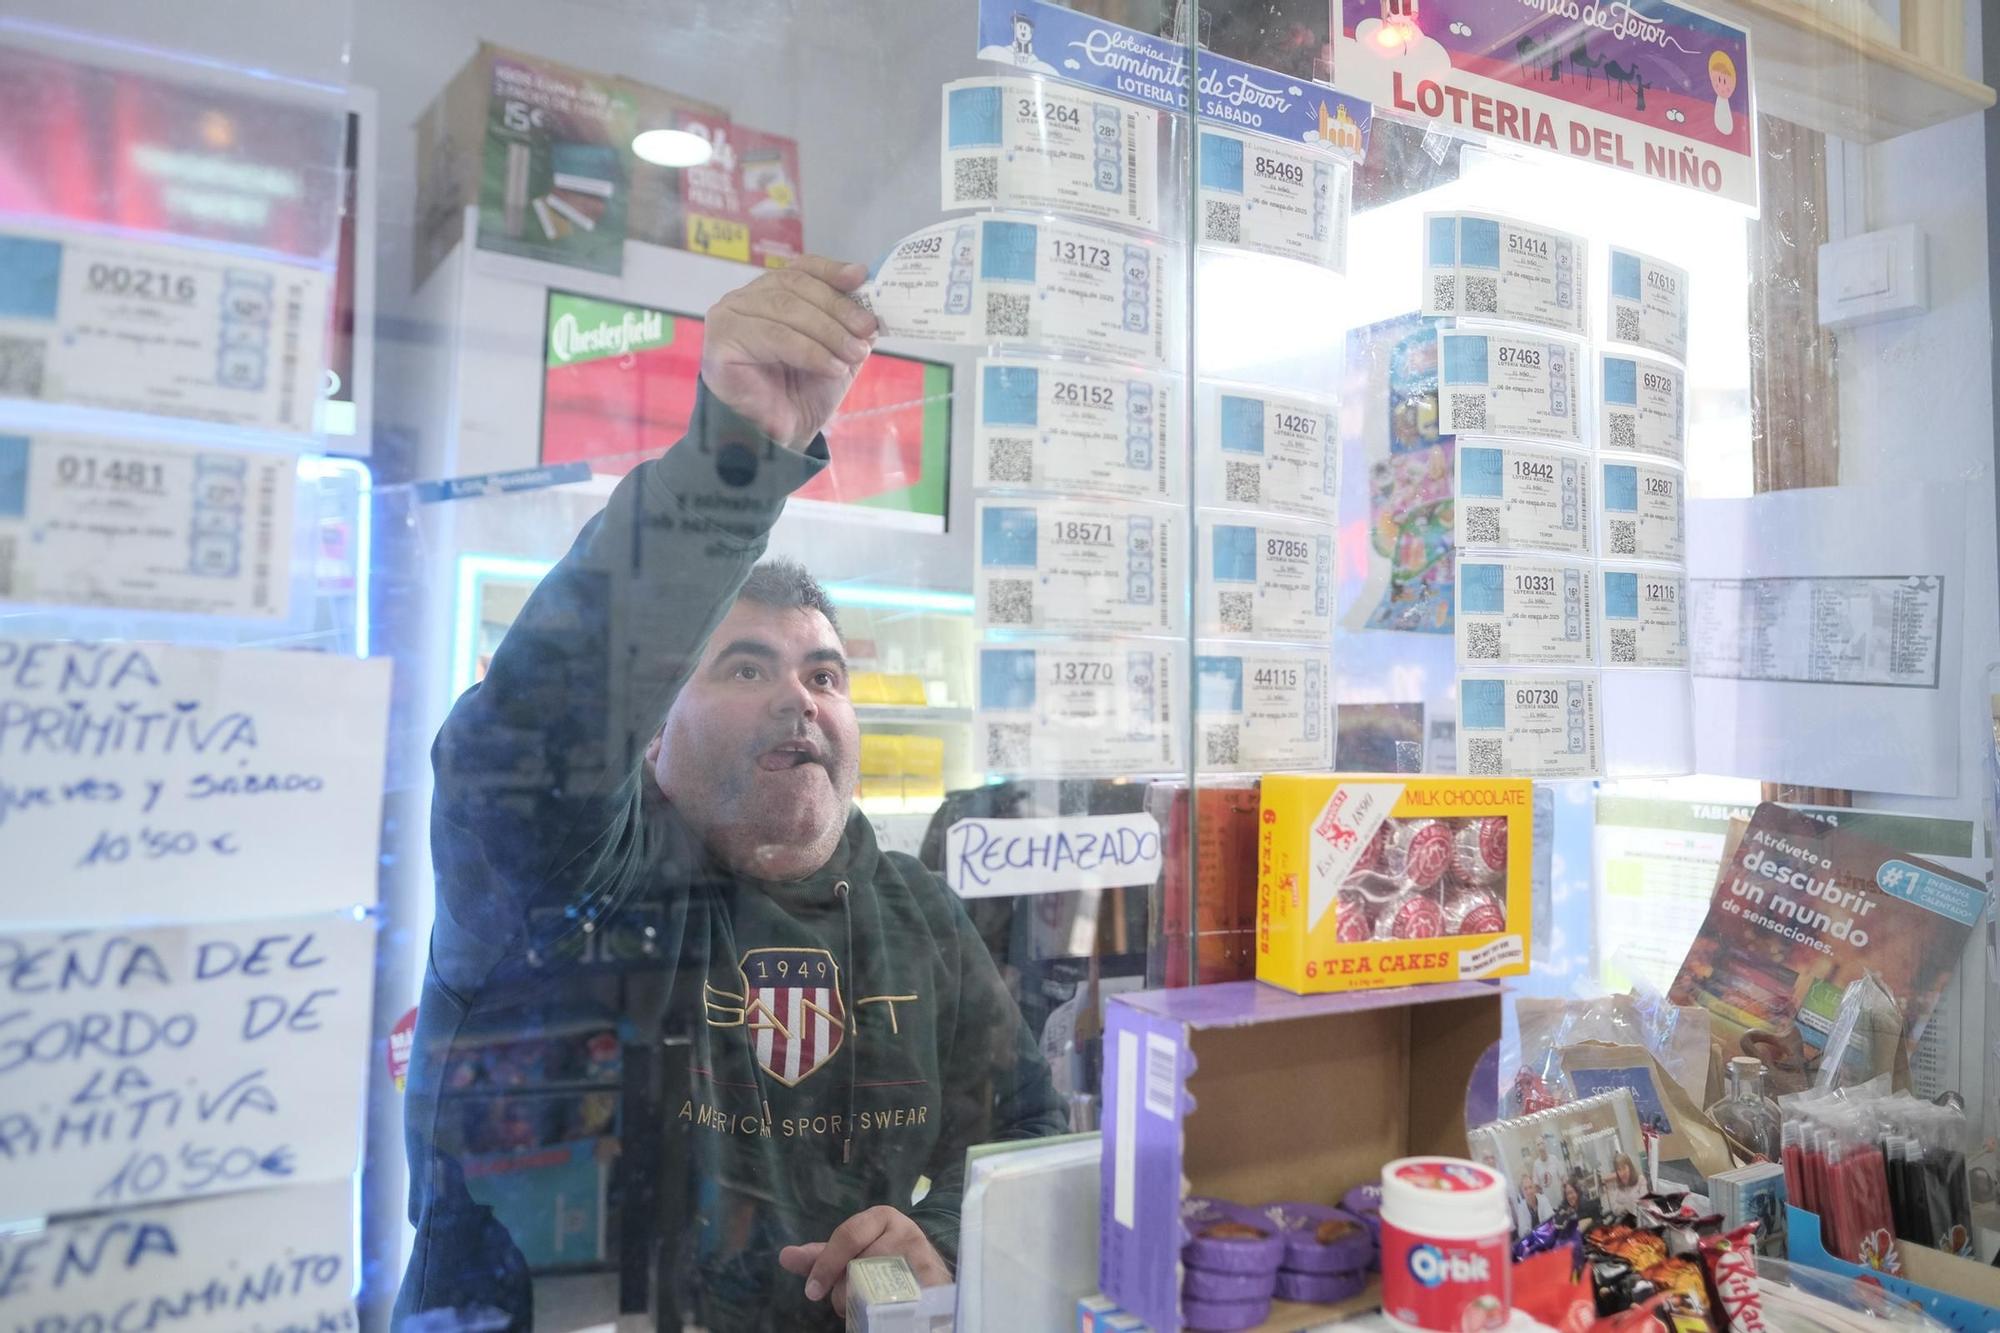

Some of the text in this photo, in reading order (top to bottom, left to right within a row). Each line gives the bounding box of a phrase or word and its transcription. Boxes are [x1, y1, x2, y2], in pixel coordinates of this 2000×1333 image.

[1582, 0, 1608, 27] de
[1610, 0, 1667, 48] Teror
[1116, 75, 1175, 105] LOTERIA
[1178, 93, 1203, 113] DL
[1206, 101, 1263, 128] SÁBADO
[1199, 69, 1228, 98] de
[1227, 73, 1293, 114] Teror
[1391, 70, 1723, 193] LOTERIA DEL NIÑO
[1255, 156, 1303, 182] 85469
[1052, 239, 1110, 267] 13173
[1508, 233, 1548, 255] 51414
[88, 263, 198, 301] 00216
[1647, 270, 1676, 292] 47619
[551, 309, 663, 370] Chesterfield
[1499, 346, 1540, 365] 87463
[1054, 382, 1113, 405] 26152
[1643, 372, 1672, 392] 69728
[1275, 413, 1317, 435] 14267
[57, 454, 166, 489] 01481
[1514, 460, 1553, 479] 18442
[1644, 477, 1673, 495] 12687
[1054, 521, 1112, 542] 18571
[1267, 538, 1308, 558] 87856
[1515, 574, 1555, 591] 10331
[1646, 583, 1675, 599] 12116
[1053, 662, 1113, 680] 13770
[1254, 668, 1297, 686] 44115
[1516, 689, 1558, 704] 60730
[0, 699, 259, 755] PRIMITIVA
[144, 777, 165, 814] y
[1405, 789, 1526, 807] MILK CHOCOLATE
[1262, 809, 1276, 824] 6
[951, 822, 1159, 891] RECHAZADO
[1262, 831, 1272, 877] TEA
[1752, 829, 1819, 865] Atrévete
[1820, 858, 1832, 870] a
[1742, 849, 1877, 917] descubrir
[1881, 867, 1921, 896] #1
[1721, 898, 1835, 956] de sensaciones.
[1730, 877, 1870, 948] un mundo
[195, 933, 328, 981] DEL
[756, 960, 827, 979] 1949
[1305, 960, 1317, 978] 6
[1324, 955, 1373, 976] TEA
[1378, 951, 1450, 973] CAKES
[242, 988, 339, 1041] DE
[70, 1064, 153, 1105] LA
[0, 1070, 278, 1160] RIMITIVA
[678, 1099, 772, 1139] AMERICAN
[0, 1221, 179, 1298] EÑA
[1408, 1245, 1491, 1287] Orbit
[1716, 1258, 1766, 1333] KitKat
